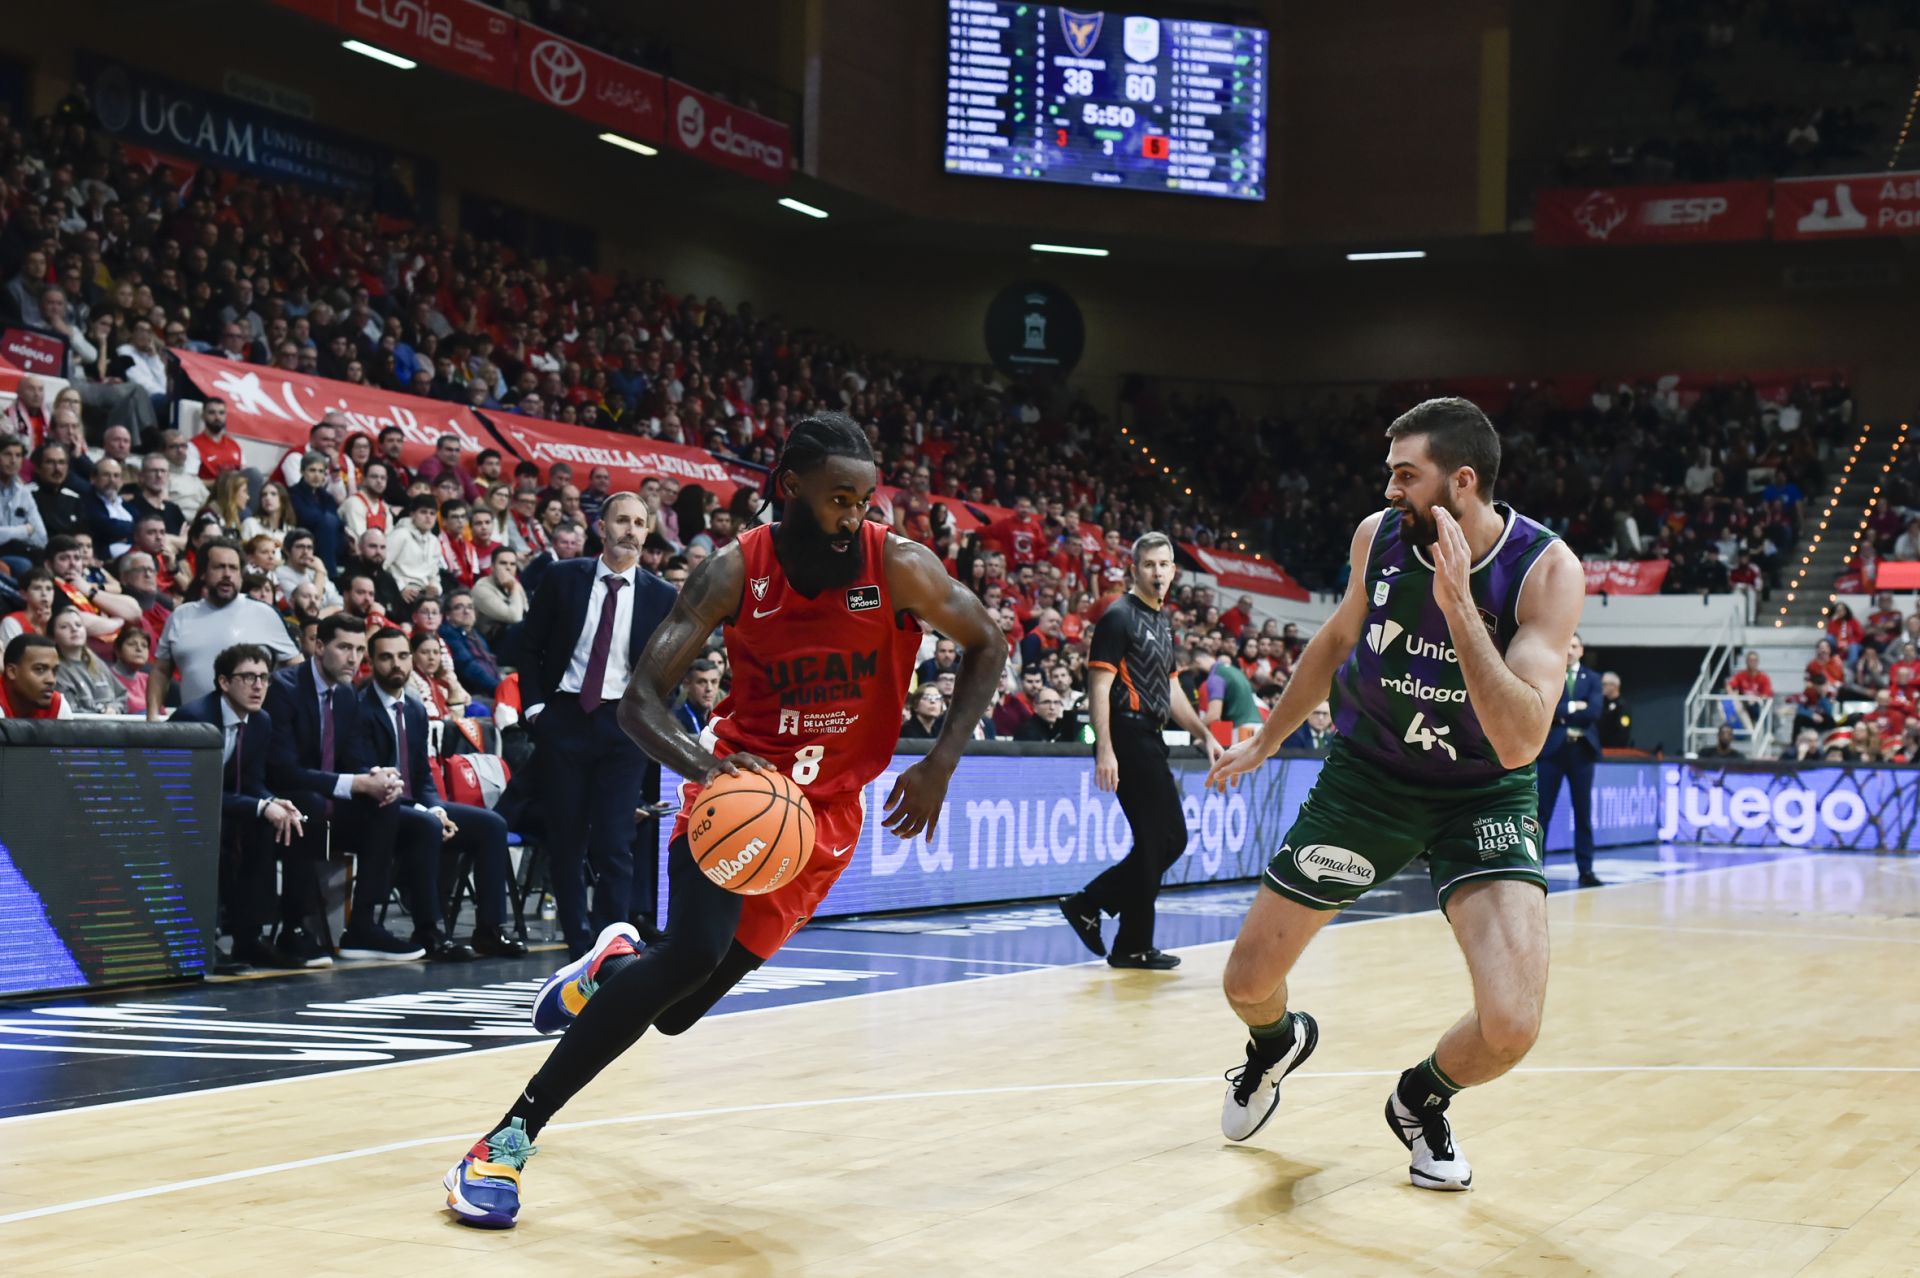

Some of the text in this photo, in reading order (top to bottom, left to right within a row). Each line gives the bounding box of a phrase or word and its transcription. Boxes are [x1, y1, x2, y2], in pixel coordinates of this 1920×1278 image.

[1063, 68, 1094, 96] 38
[1125, 74, 1156, 103] 60
[139, 88, 258, 165] UCAM
[1082, 103, 1135, 128] 5:50
[1056, 129, 1068, 148] 3
[1660, 196, 1728, 225] ESP
[546, 443, 644, 468] ESTRELLA
[651, 453, 728, 482] LEVANTE
[1405, 634, 1460, 663] Unic
[765, 650, 878, 691] UCAM
[780, 683, 862, 707] MURCIA
[803, 720, 814, 728] DE
[824, 717, 844, 726] CRUZ
[804, 710, 846, 720] CARAVACA
[791, 745, 825, 785] 8
[1600, 769, 1658, 829] mucho
[1657, 769, 1869, 846] juego
[691, 819, 713, 842] acb
[966, 771, 1133, 870] mucho
[1182, 793, 1247, 876] ego
[702, 836, 768, 887] Wilson
